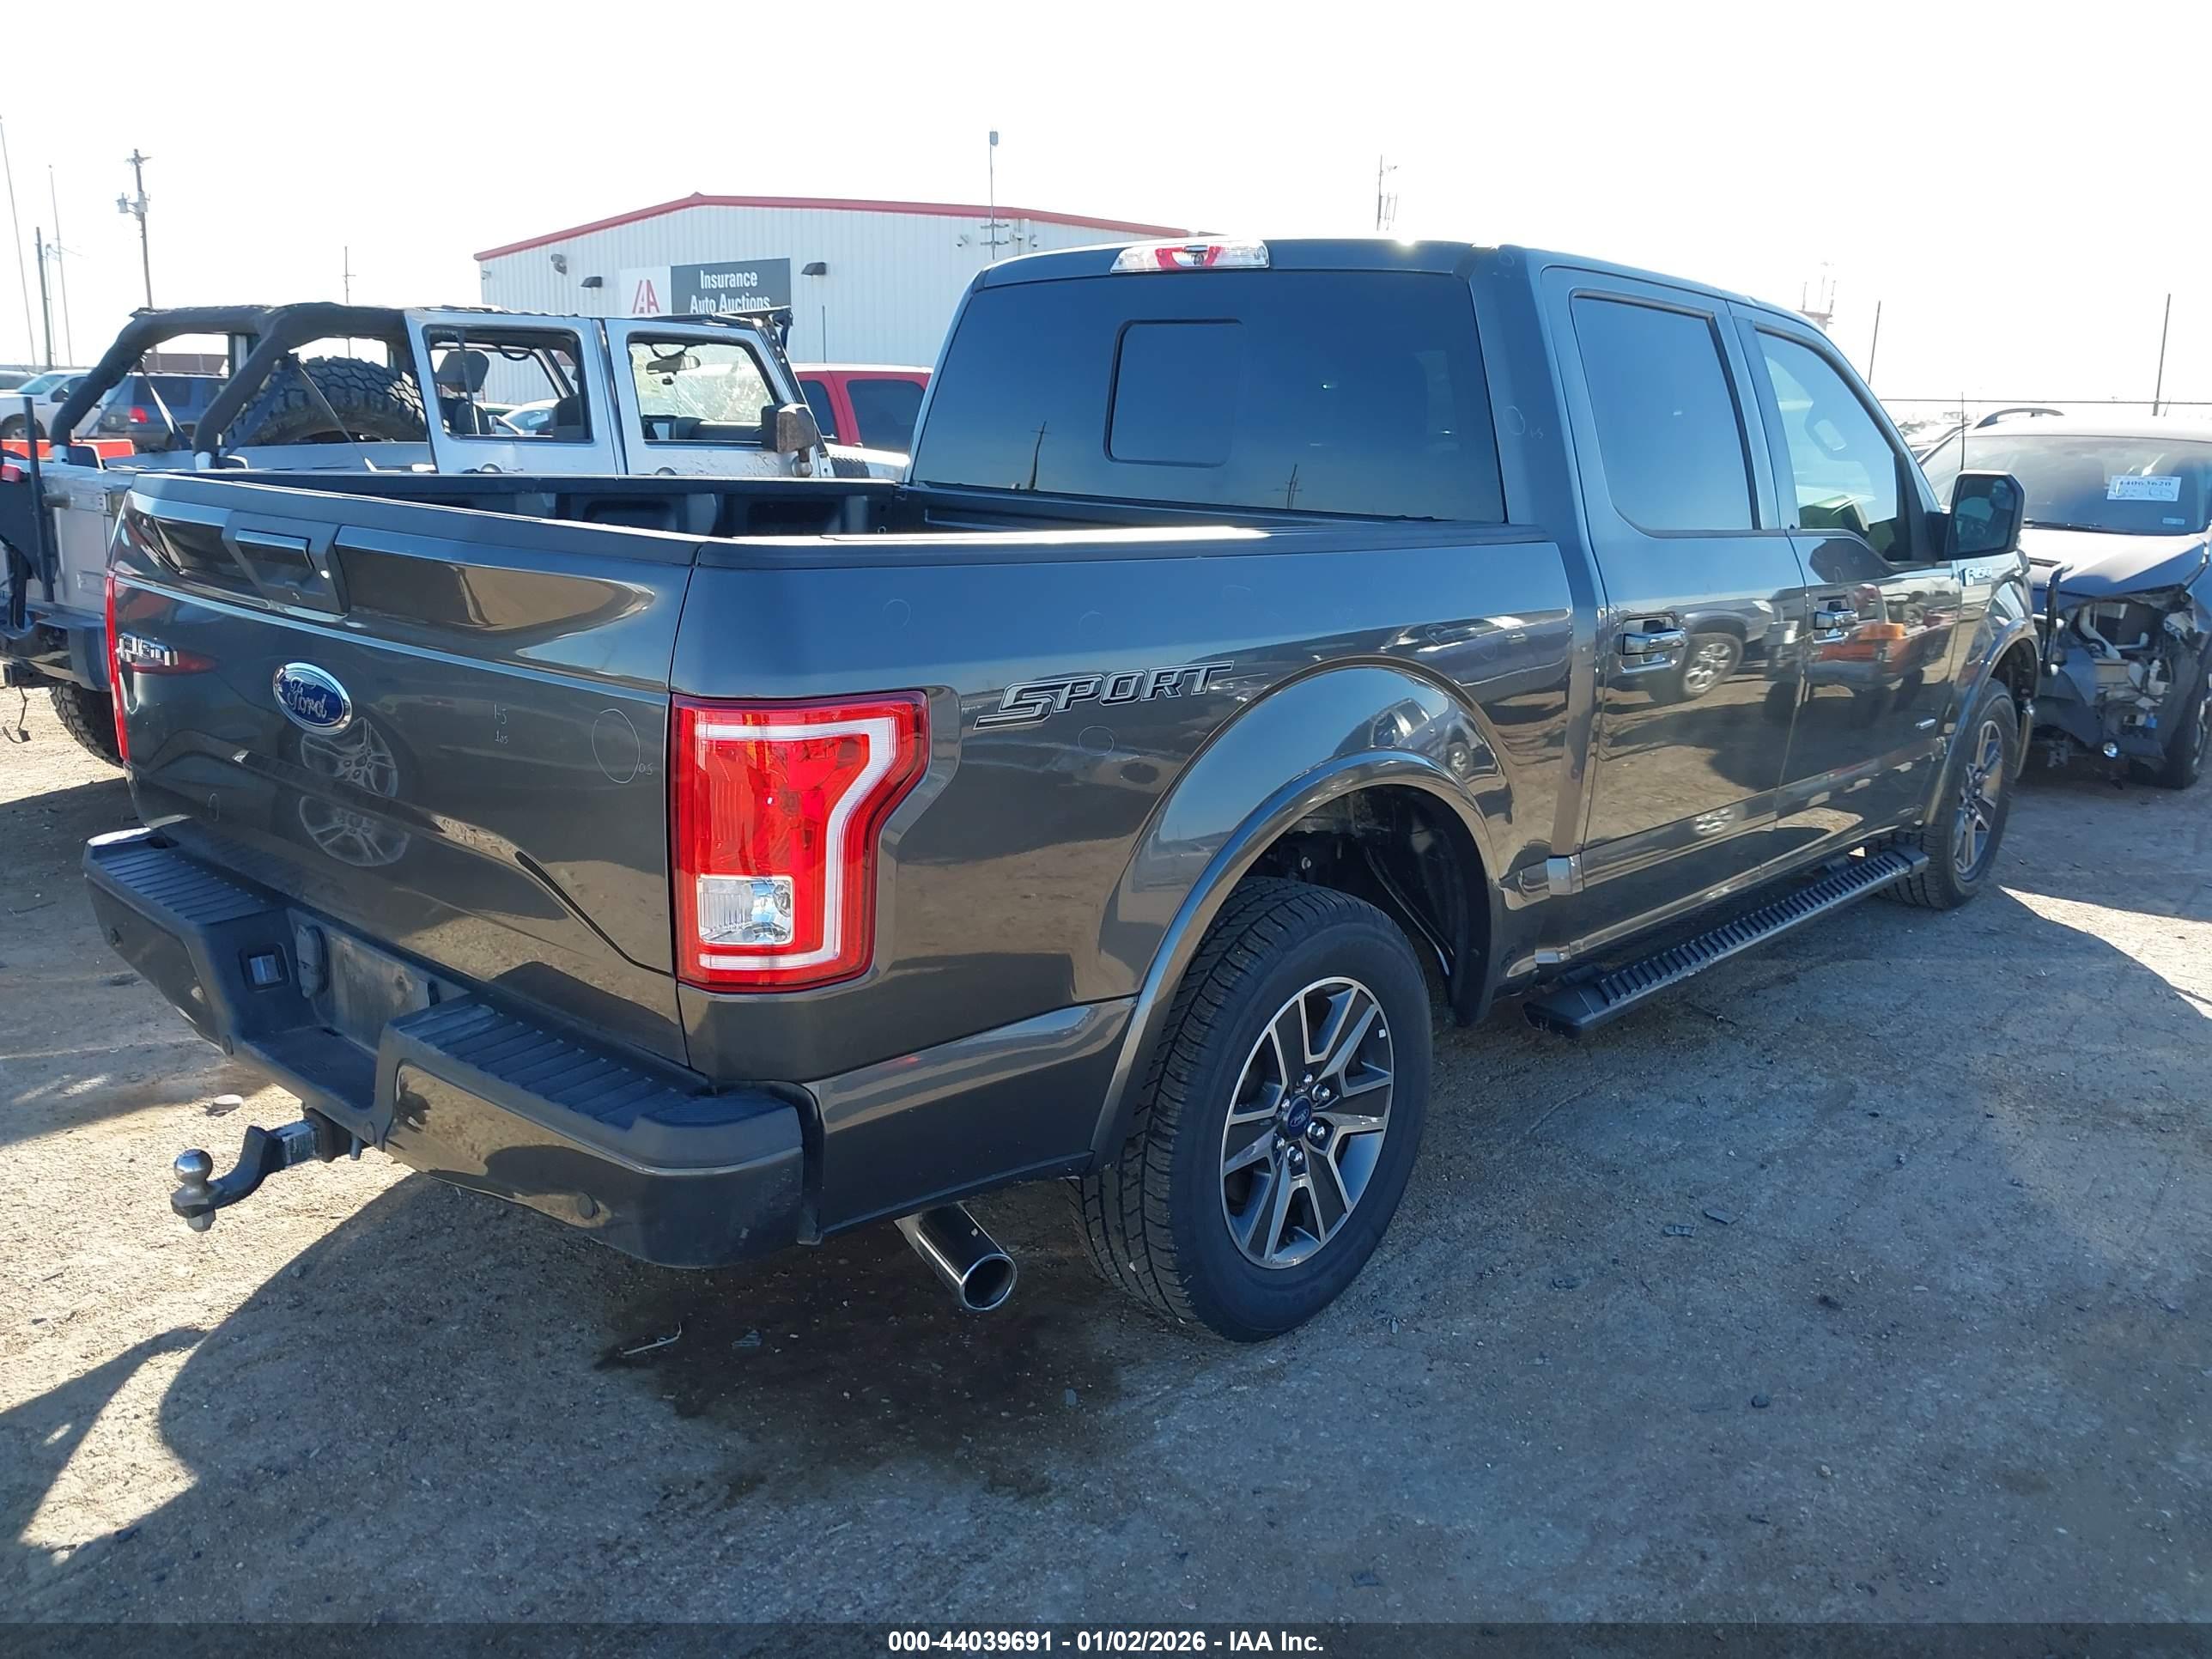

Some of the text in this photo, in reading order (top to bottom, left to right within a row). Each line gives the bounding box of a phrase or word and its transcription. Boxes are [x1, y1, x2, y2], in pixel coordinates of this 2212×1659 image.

[700, 270, 757, 289] Insurance
[690, 292, 771, 314] Auto Auctions
[286, 676, 328, 719] Ford
[973, 659, 1235, 731] SPORT
